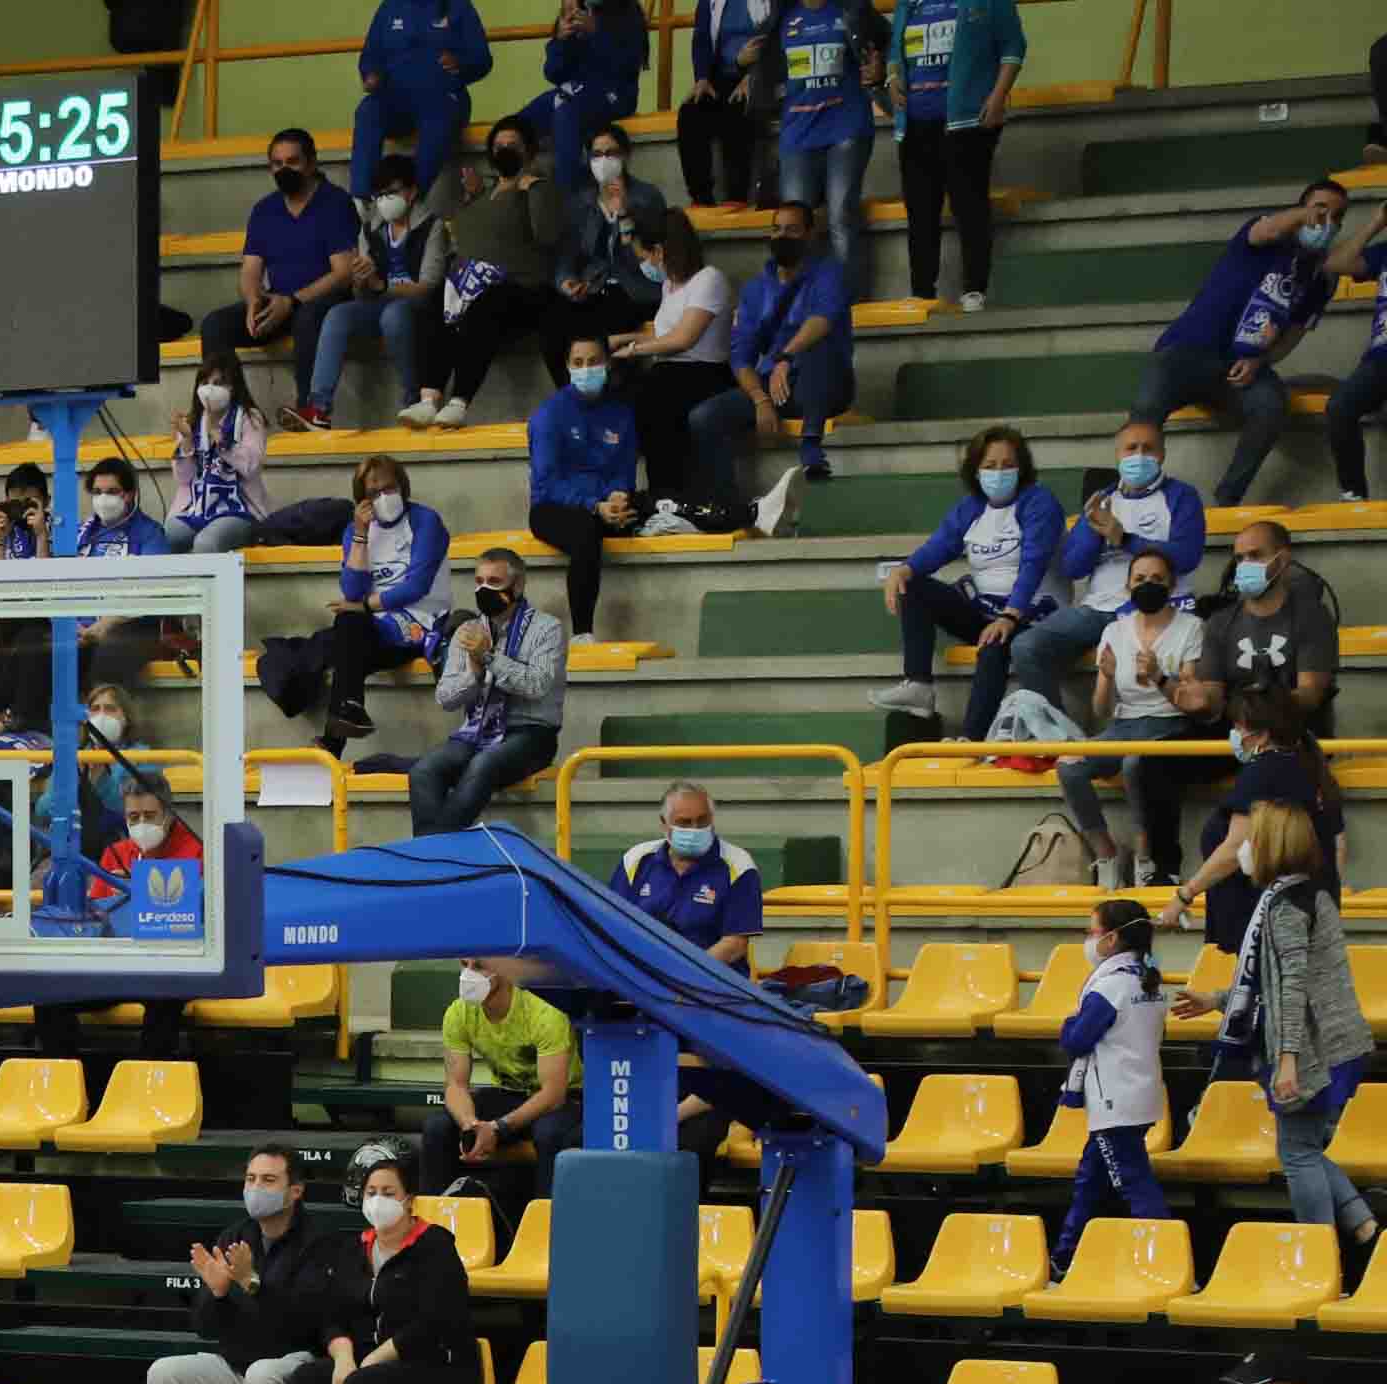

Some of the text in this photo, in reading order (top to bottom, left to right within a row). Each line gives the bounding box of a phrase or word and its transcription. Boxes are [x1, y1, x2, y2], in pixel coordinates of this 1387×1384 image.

[283, 925, 339, 945] MONDO
[427, 1094, 445, 1105] FIL
[612, 1062, 634, 1160] MONDO
[323, 1151, 332, 1161] 4
[166, 1277, 202, 1289] FILA 3
